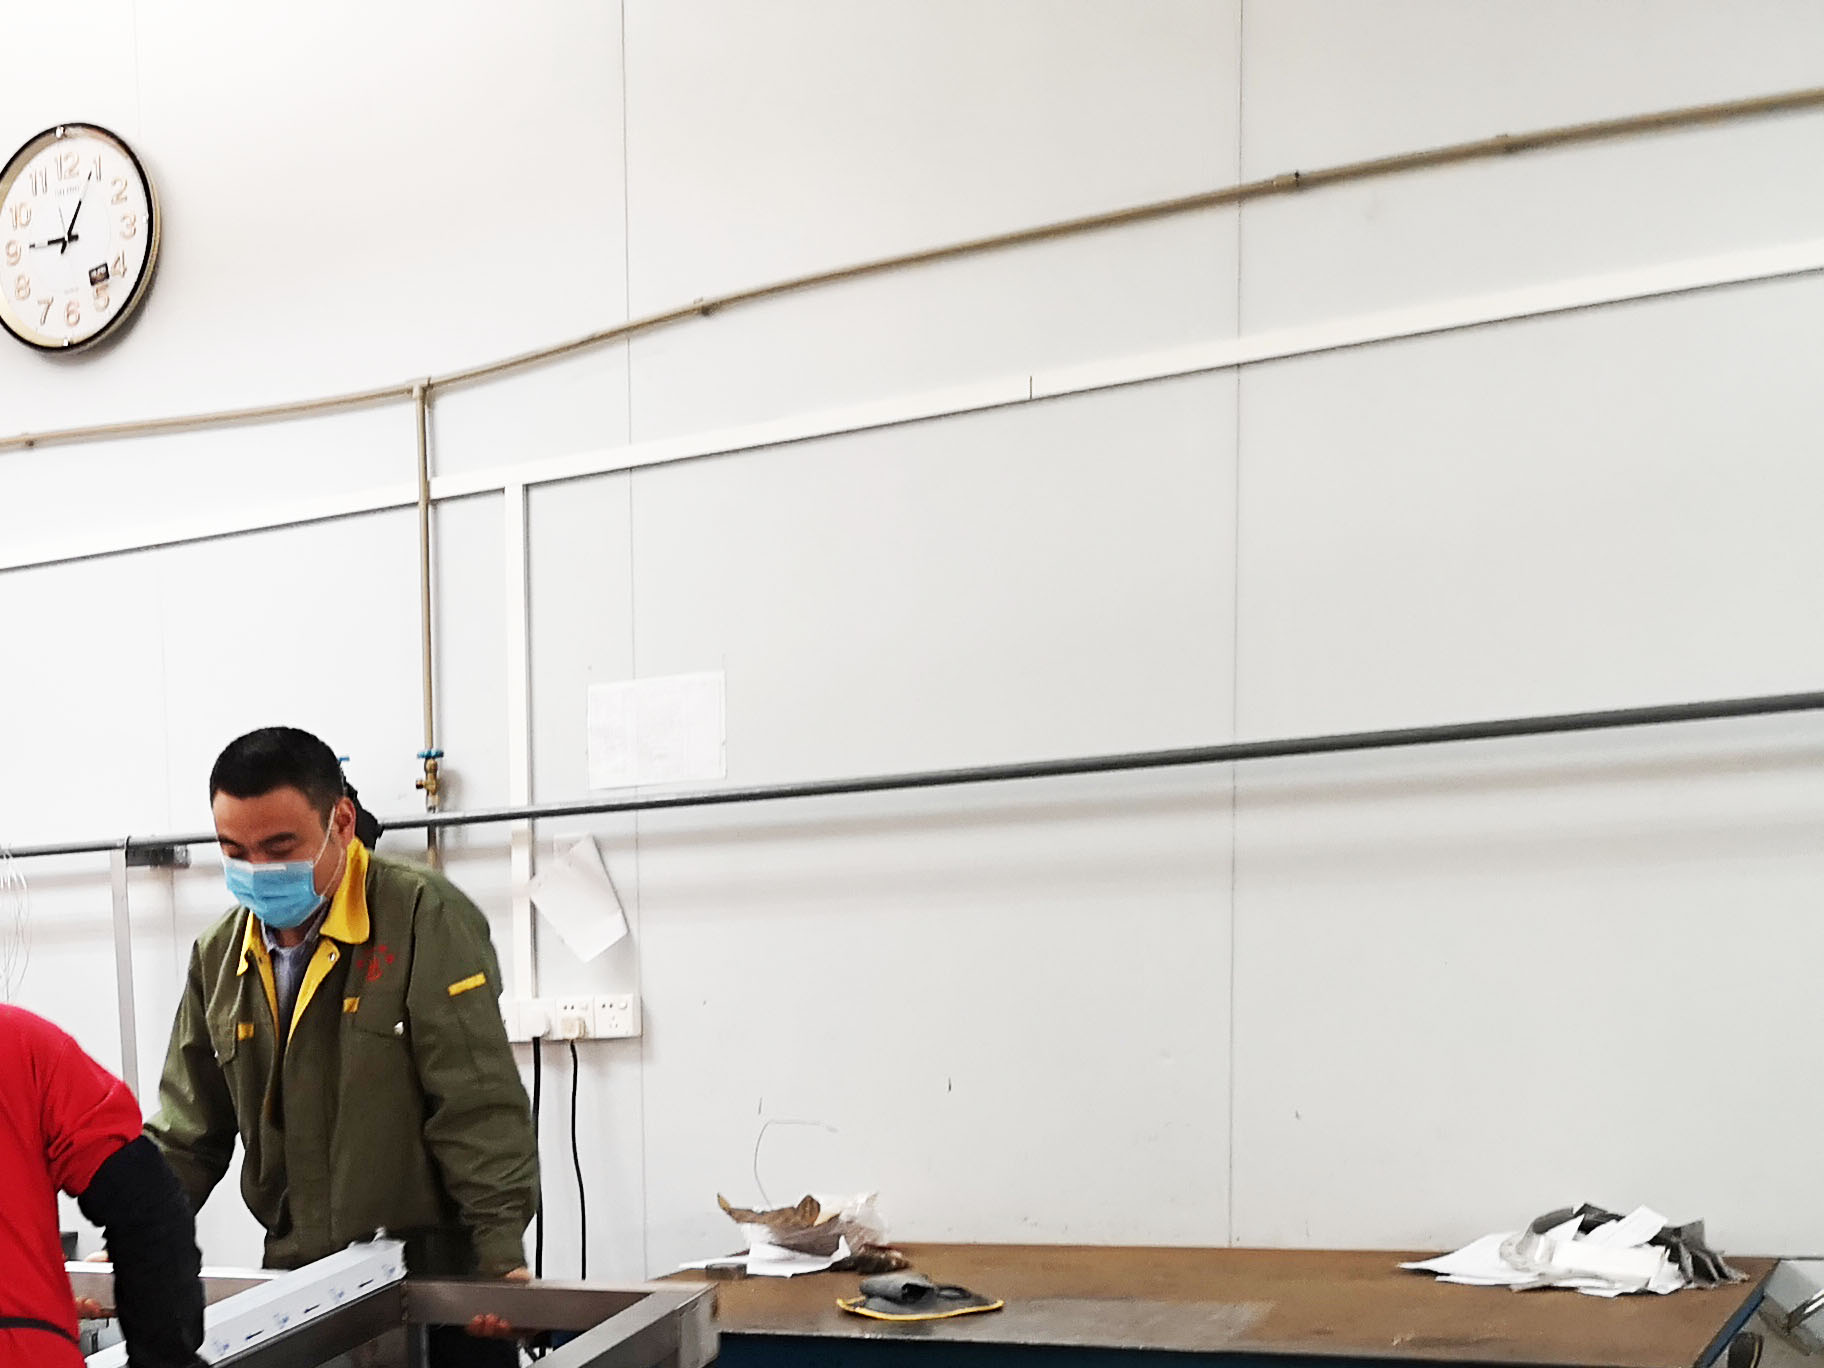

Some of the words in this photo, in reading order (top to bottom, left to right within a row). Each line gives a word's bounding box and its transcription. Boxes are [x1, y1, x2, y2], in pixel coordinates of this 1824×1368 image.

[54, 152, 80, 181] 12
[29, 167, 49, 197] 11
[111, 177, 128, 205] 2
[10, 203, 32, 230] 10
[120, 214, 136, 240] 3
[5, 240, 22, 266] 9
[111, 250, 128, 279] 4
[15, 275, 31, 301] 8
[93, 284, 110, 312] 5
[37, 296, 54, 325] 7
[65, 300, 81, 328] 6
